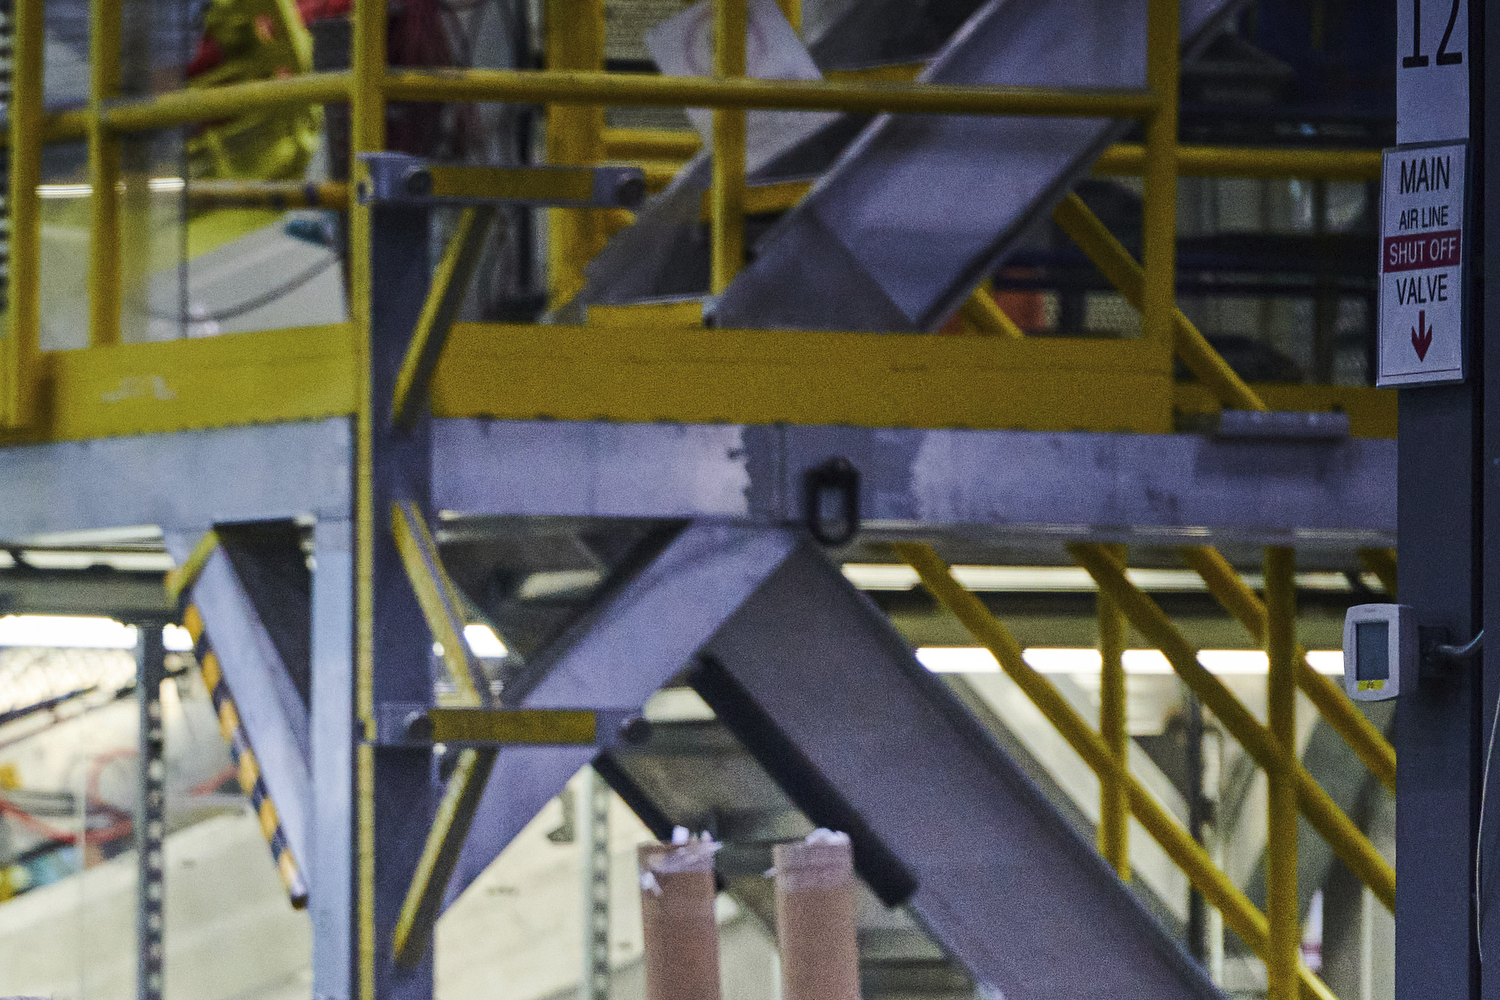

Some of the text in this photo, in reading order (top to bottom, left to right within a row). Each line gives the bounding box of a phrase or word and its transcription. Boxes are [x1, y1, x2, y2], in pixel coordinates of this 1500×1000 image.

[1403, 0, 1462, 69] 12
[1400, 156, 1451, 194] MAIN
[1399, 205, 1449, 230] AIR LINE
[1389, 237, 1457, 266] SHUT OFF
[1396, 274, 1449, 305] VALVE
